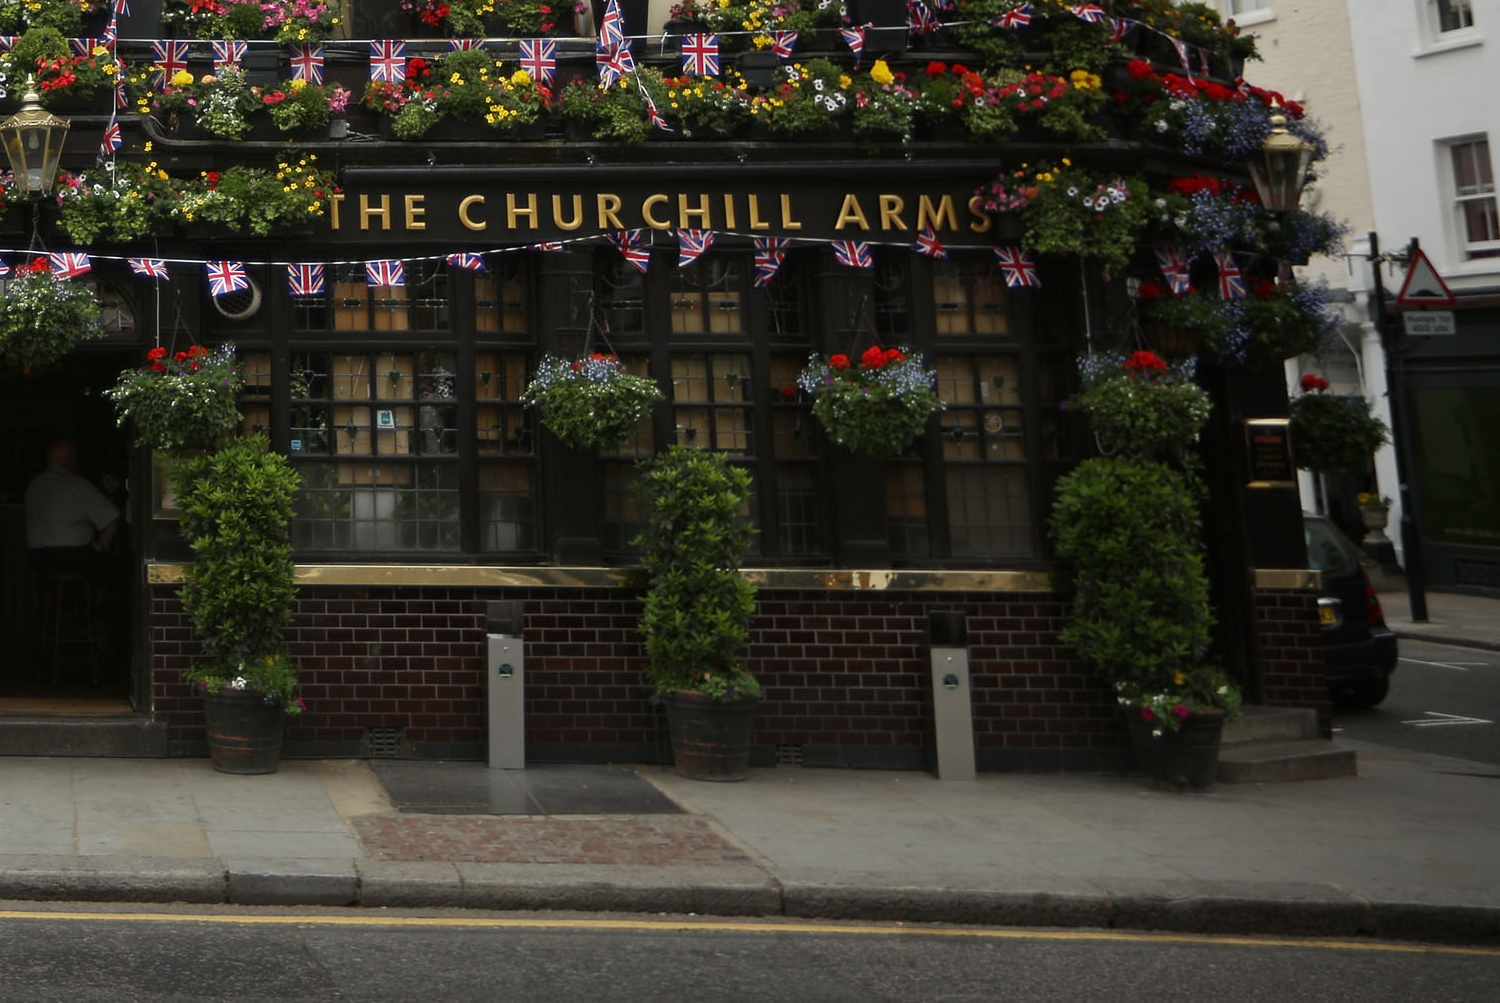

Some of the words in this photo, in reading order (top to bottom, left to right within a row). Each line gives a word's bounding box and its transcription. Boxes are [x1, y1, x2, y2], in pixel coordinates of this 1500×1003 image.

[328, 193, 426, 230] THE
[457, 192, 802, 231] CHURCHILL
[834, 193, 991, 233] ARMS
